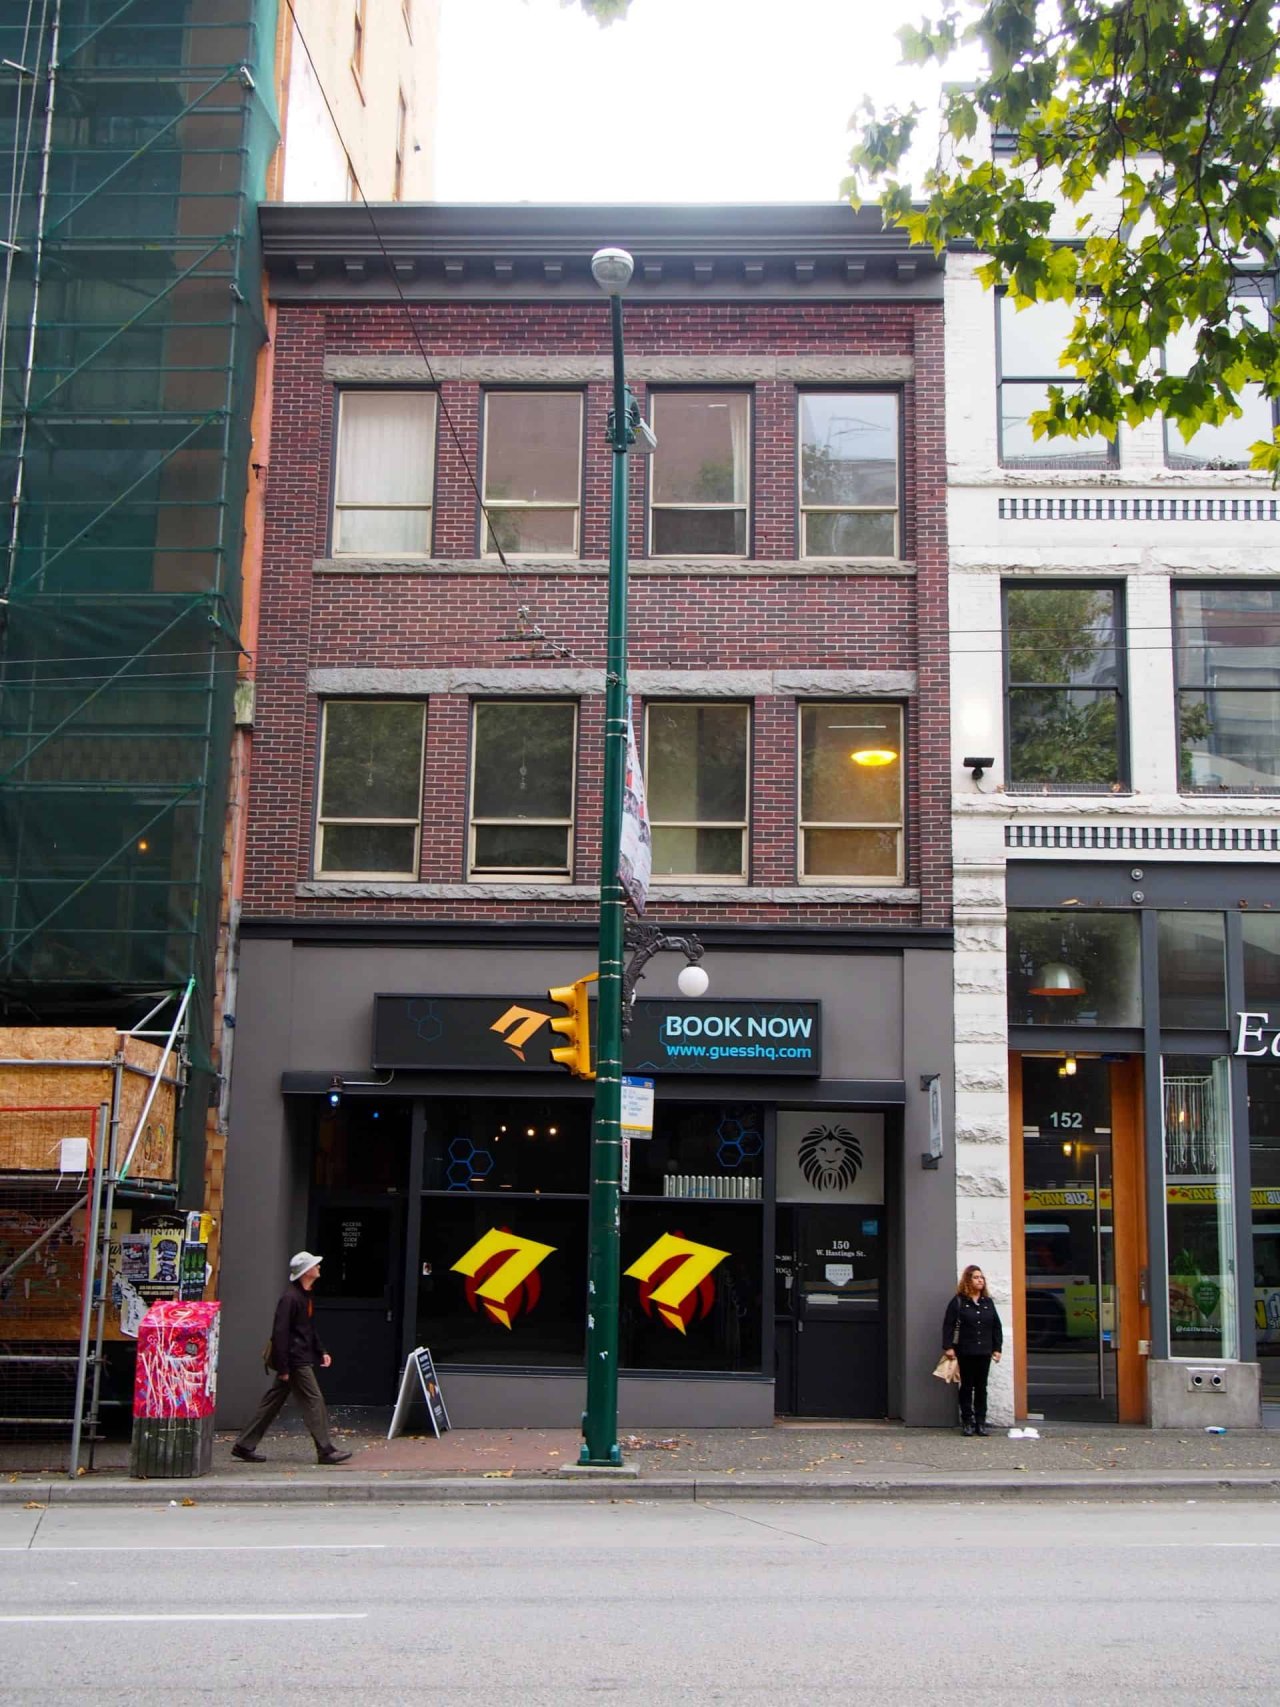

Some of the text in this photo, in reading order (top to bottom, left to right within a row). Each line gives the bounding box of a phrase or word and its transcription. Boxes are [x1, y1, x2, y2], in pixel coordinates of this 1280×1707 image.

[666, 1016, 813, 1038] BOOK NOW
[666, 1044, 812, 1060] www.guesshq.com
[1049, 1112, 1083, 1128] 152
[831, 1240, 850, 1250] 150
[825, 1249, 855, 1258] Hastings
